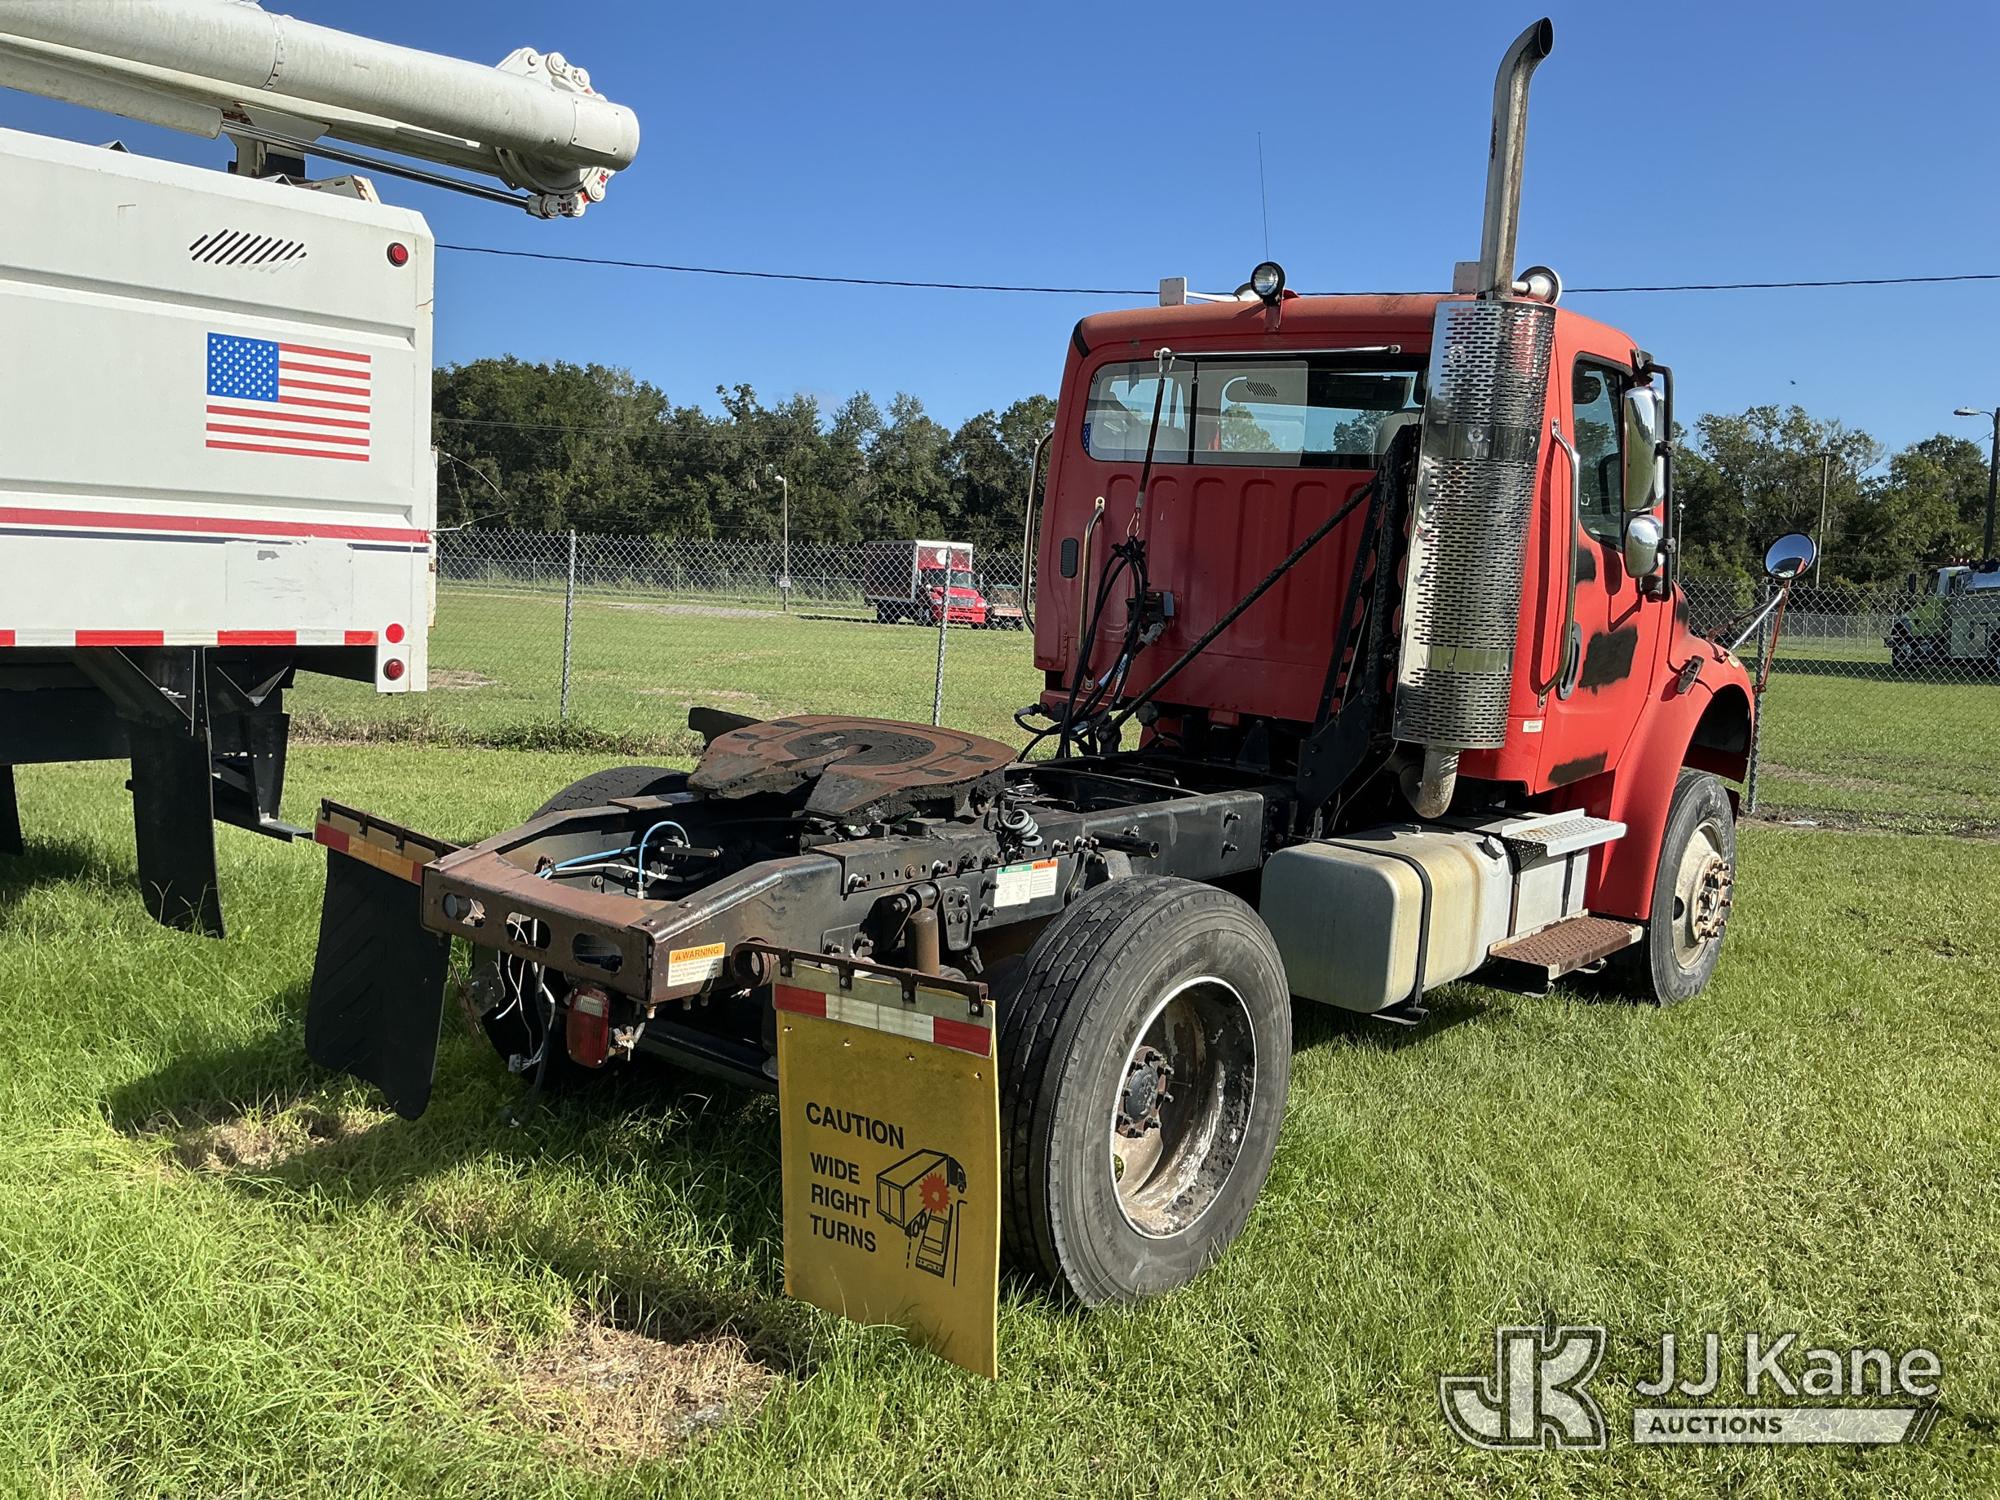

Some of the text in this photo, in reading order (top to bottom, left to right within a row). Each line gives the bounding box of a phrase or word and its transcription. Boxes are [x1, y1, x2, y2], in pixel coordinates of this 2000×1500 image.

[682, 946, 719, 959] WARNING
[806, 1102, 904, 1150] CAUTION
[810, 1152, 860, 1185] WIDE
[811, 1183, 871, 1218] RIGHT
[810, 1214, 876, 1253] TURNS
